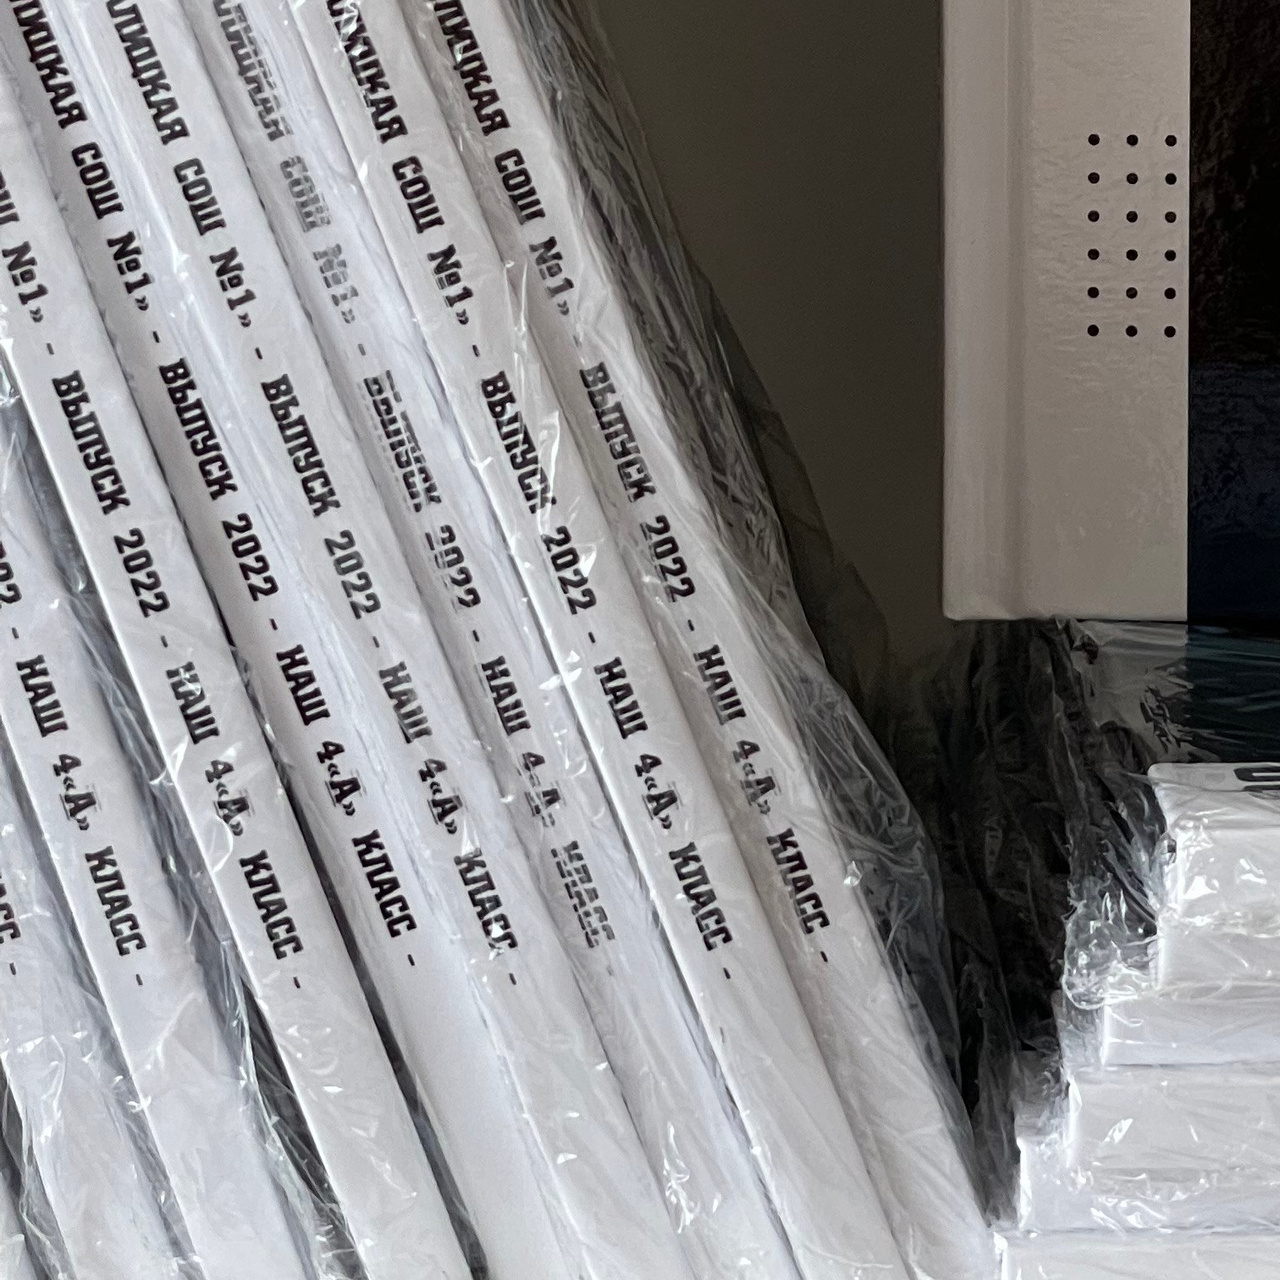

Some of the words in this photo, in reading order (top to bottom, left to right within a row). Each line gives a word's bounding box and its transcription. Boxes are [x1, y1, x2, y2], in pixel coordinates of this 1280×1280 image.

[2, 241, 48, 322] №1»
[52, 371, 131, 515] ВЫПУСК
[113, 528, 170, 618] 2022
[166, 661, 220, 746] НАШ
[240, 850, 304, 961] КЛАСС
[16, 654, 68, 738] НАШ
[53, 754, 98, 830] 4«А»
[84, 845, 146, 956] КЛАСС
[71, 142, 124, 220] СОШ
[107, 231, 155, 311] №1»
[158, 359, 239, 501] ВЫПУСК
[221, 513, 279, 603] 2022
[276, 644, 330, 727] НАШ
[315, 740, 363, 817] 4«А»
[352, 830, 417, 937] КЛАСС
[174, 157, 226, 236] СОШ
[210, 246, 256, 328] №1»
[260, 374, 340, 517] ВЫПУСК
[324, 530, 381, 620] 2022
[379, 661, 433, 744] НАШ
[418, 758, 466, 835] 4«А»
[393, 155, 444, 234] СОШ
[428, 243, 473, 325] №1»
[540, 526, 597, 616] 2022
[595, 657, 648, 740] НАШ
[634, 751, 684, 832] 4«А»
[669, 842, 733, 952] КЛАСС
[481, 656, 533, 736] НАШ
[495, 148, 546, 224] СОШ
[529, 237, 574, 316] №1»
[580, 361, 656, 502] ВЫПУСК
[643, 515, 698, 604] 2022
[694, 644, 749, 727] НАШ
[766, 828, 830, 937] КЛАСС
